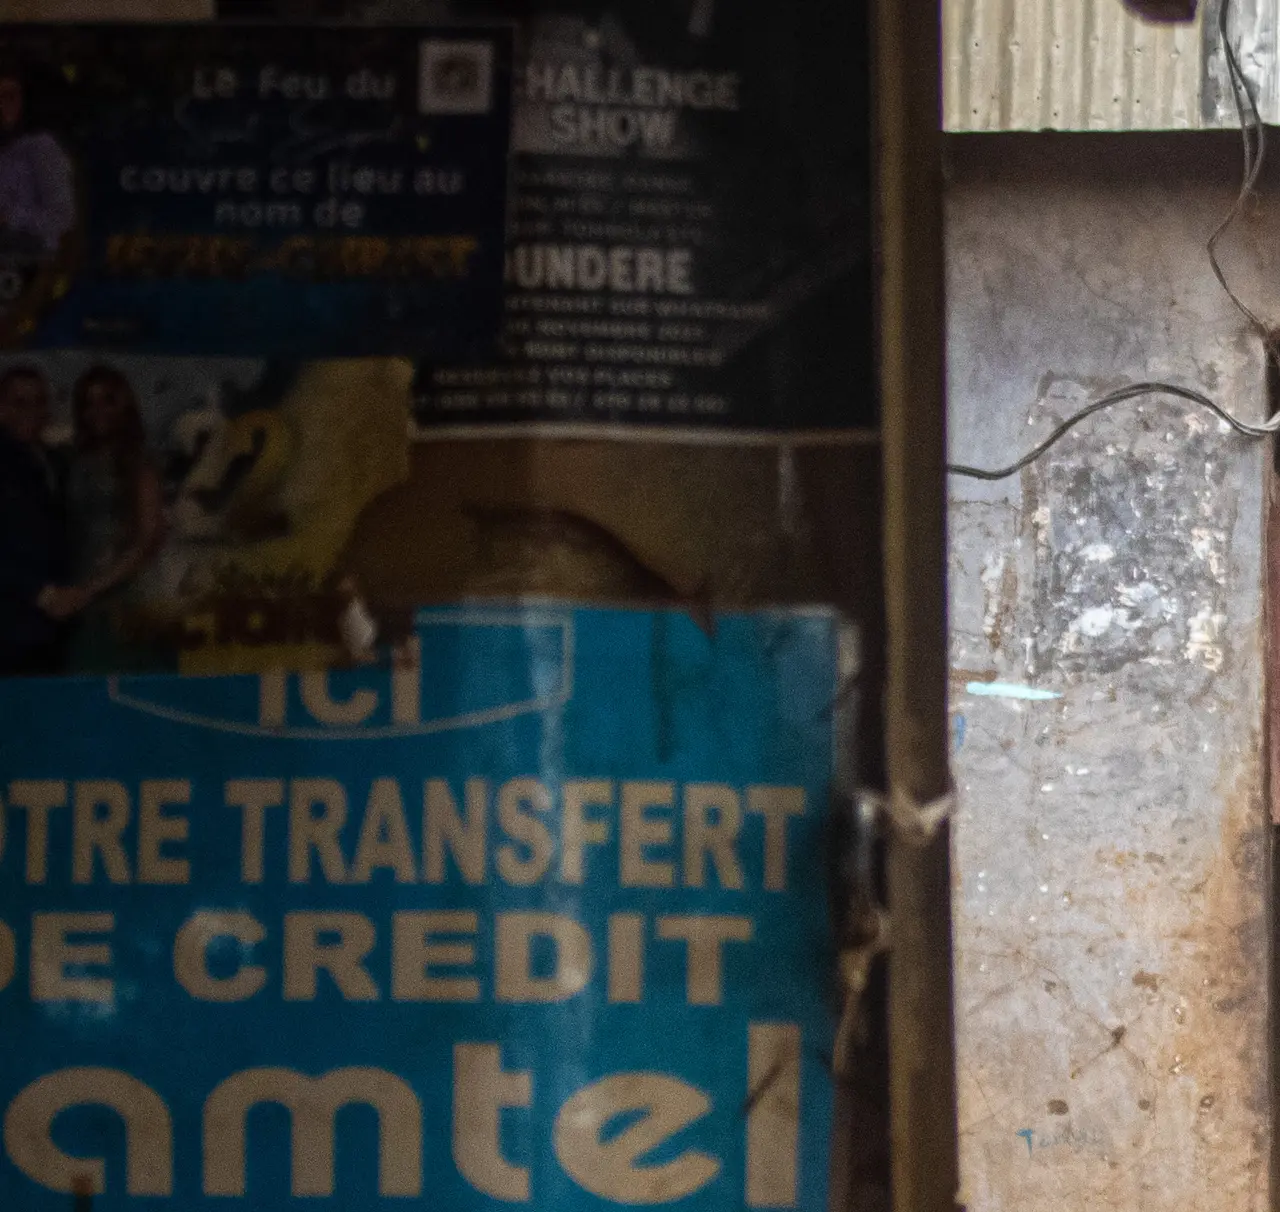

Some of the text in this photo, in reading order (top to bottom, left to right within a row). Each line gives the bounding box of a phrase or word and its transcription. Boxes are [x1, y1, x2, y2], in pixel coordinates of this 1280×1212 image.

[258, 64, 330, 100] Feu
[345, 66, 397, 100] du
[551, 105, 681, 147] SHOW
[118, 160, 464, 195] couvre ce lieu au
[213, 196, 367, 229] nom de
[504, 244, 695, 294] UNDERE
[0, 775, 806, 893] TRE TRANSFERT
[0, 906, 754, 1004] E CREDIT
[4, 1020, 801, 1208] amtel
